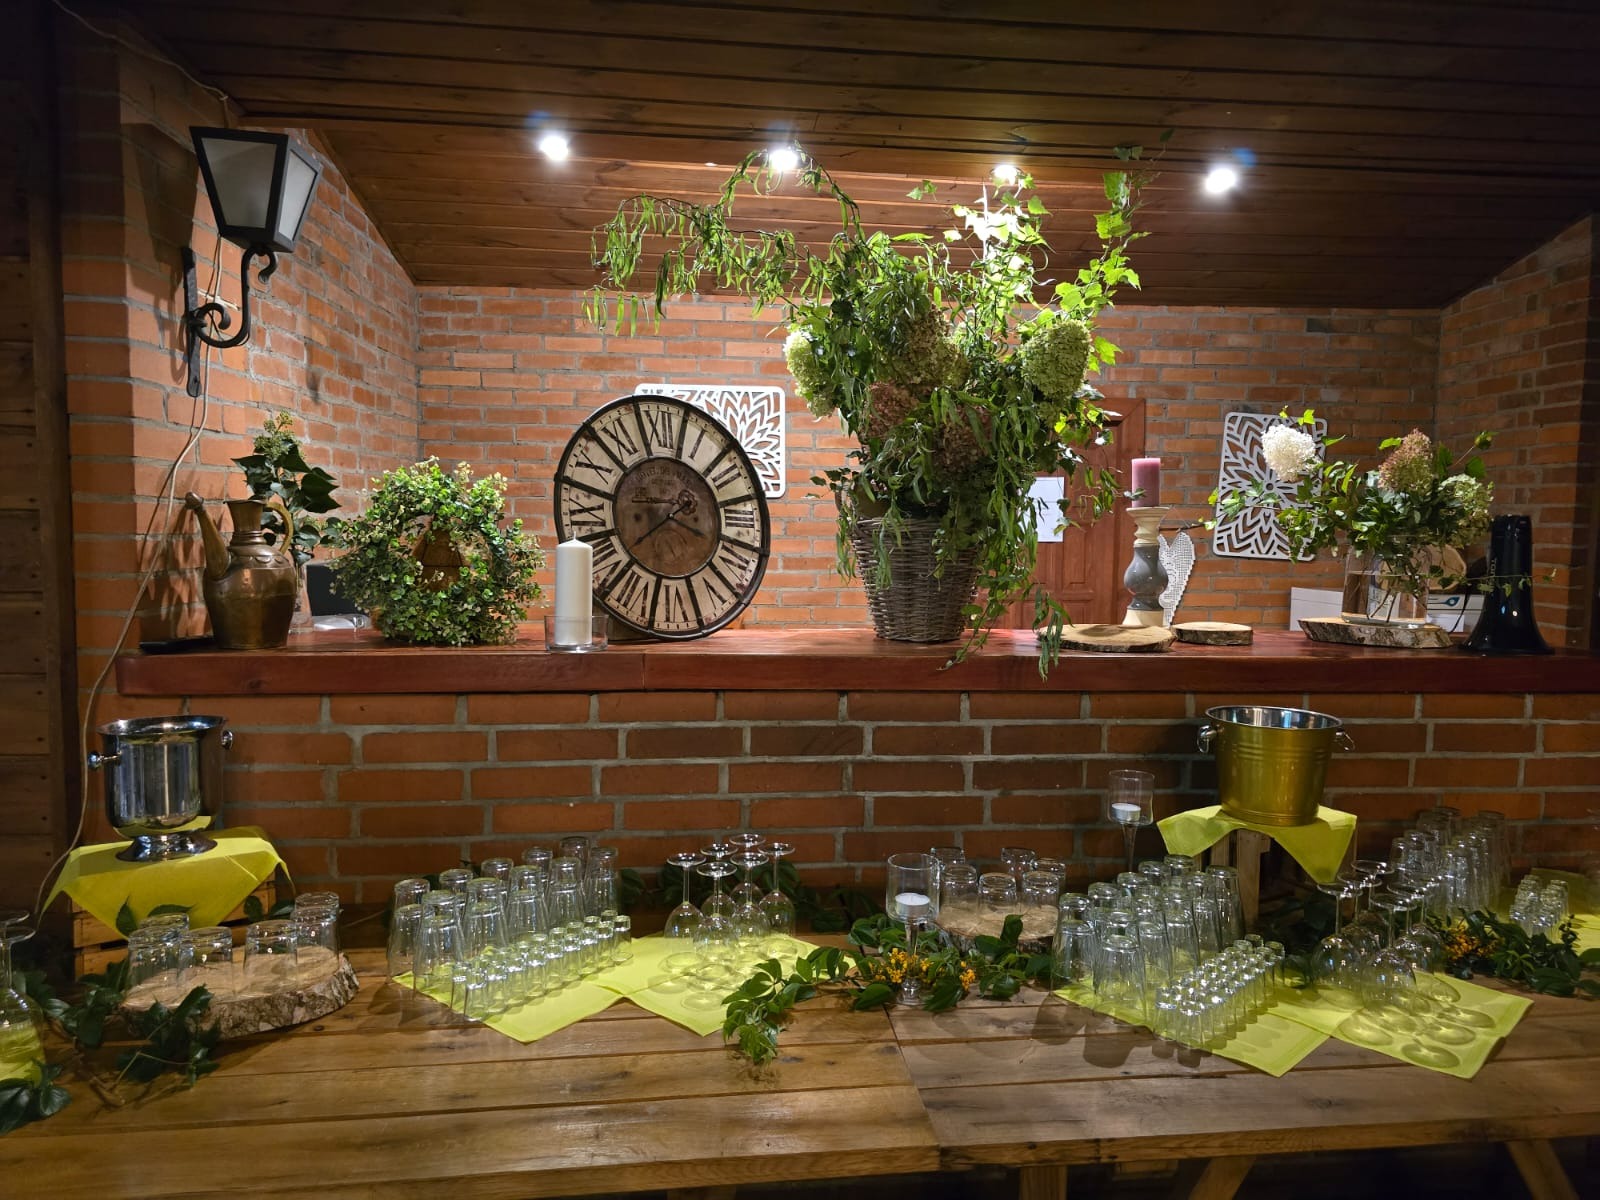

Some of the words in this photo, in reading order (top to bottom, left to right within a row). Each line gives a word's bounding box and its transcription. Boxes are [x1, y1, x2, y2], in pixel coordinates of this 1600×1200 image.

[601, 417, 638, 462] XI
[688, 427, 708, 459] I
[575, 450, 612, 484] X
[711, 464, 742, 491] II
[569, 498, 605, 527] IX
[724, 507, 755, 528] III
[718, 542, 751, 583] IV
[616, 569, 649, 618] VII
[664, 585, 689, 622] VI
[703, 577, 728, 610] V
